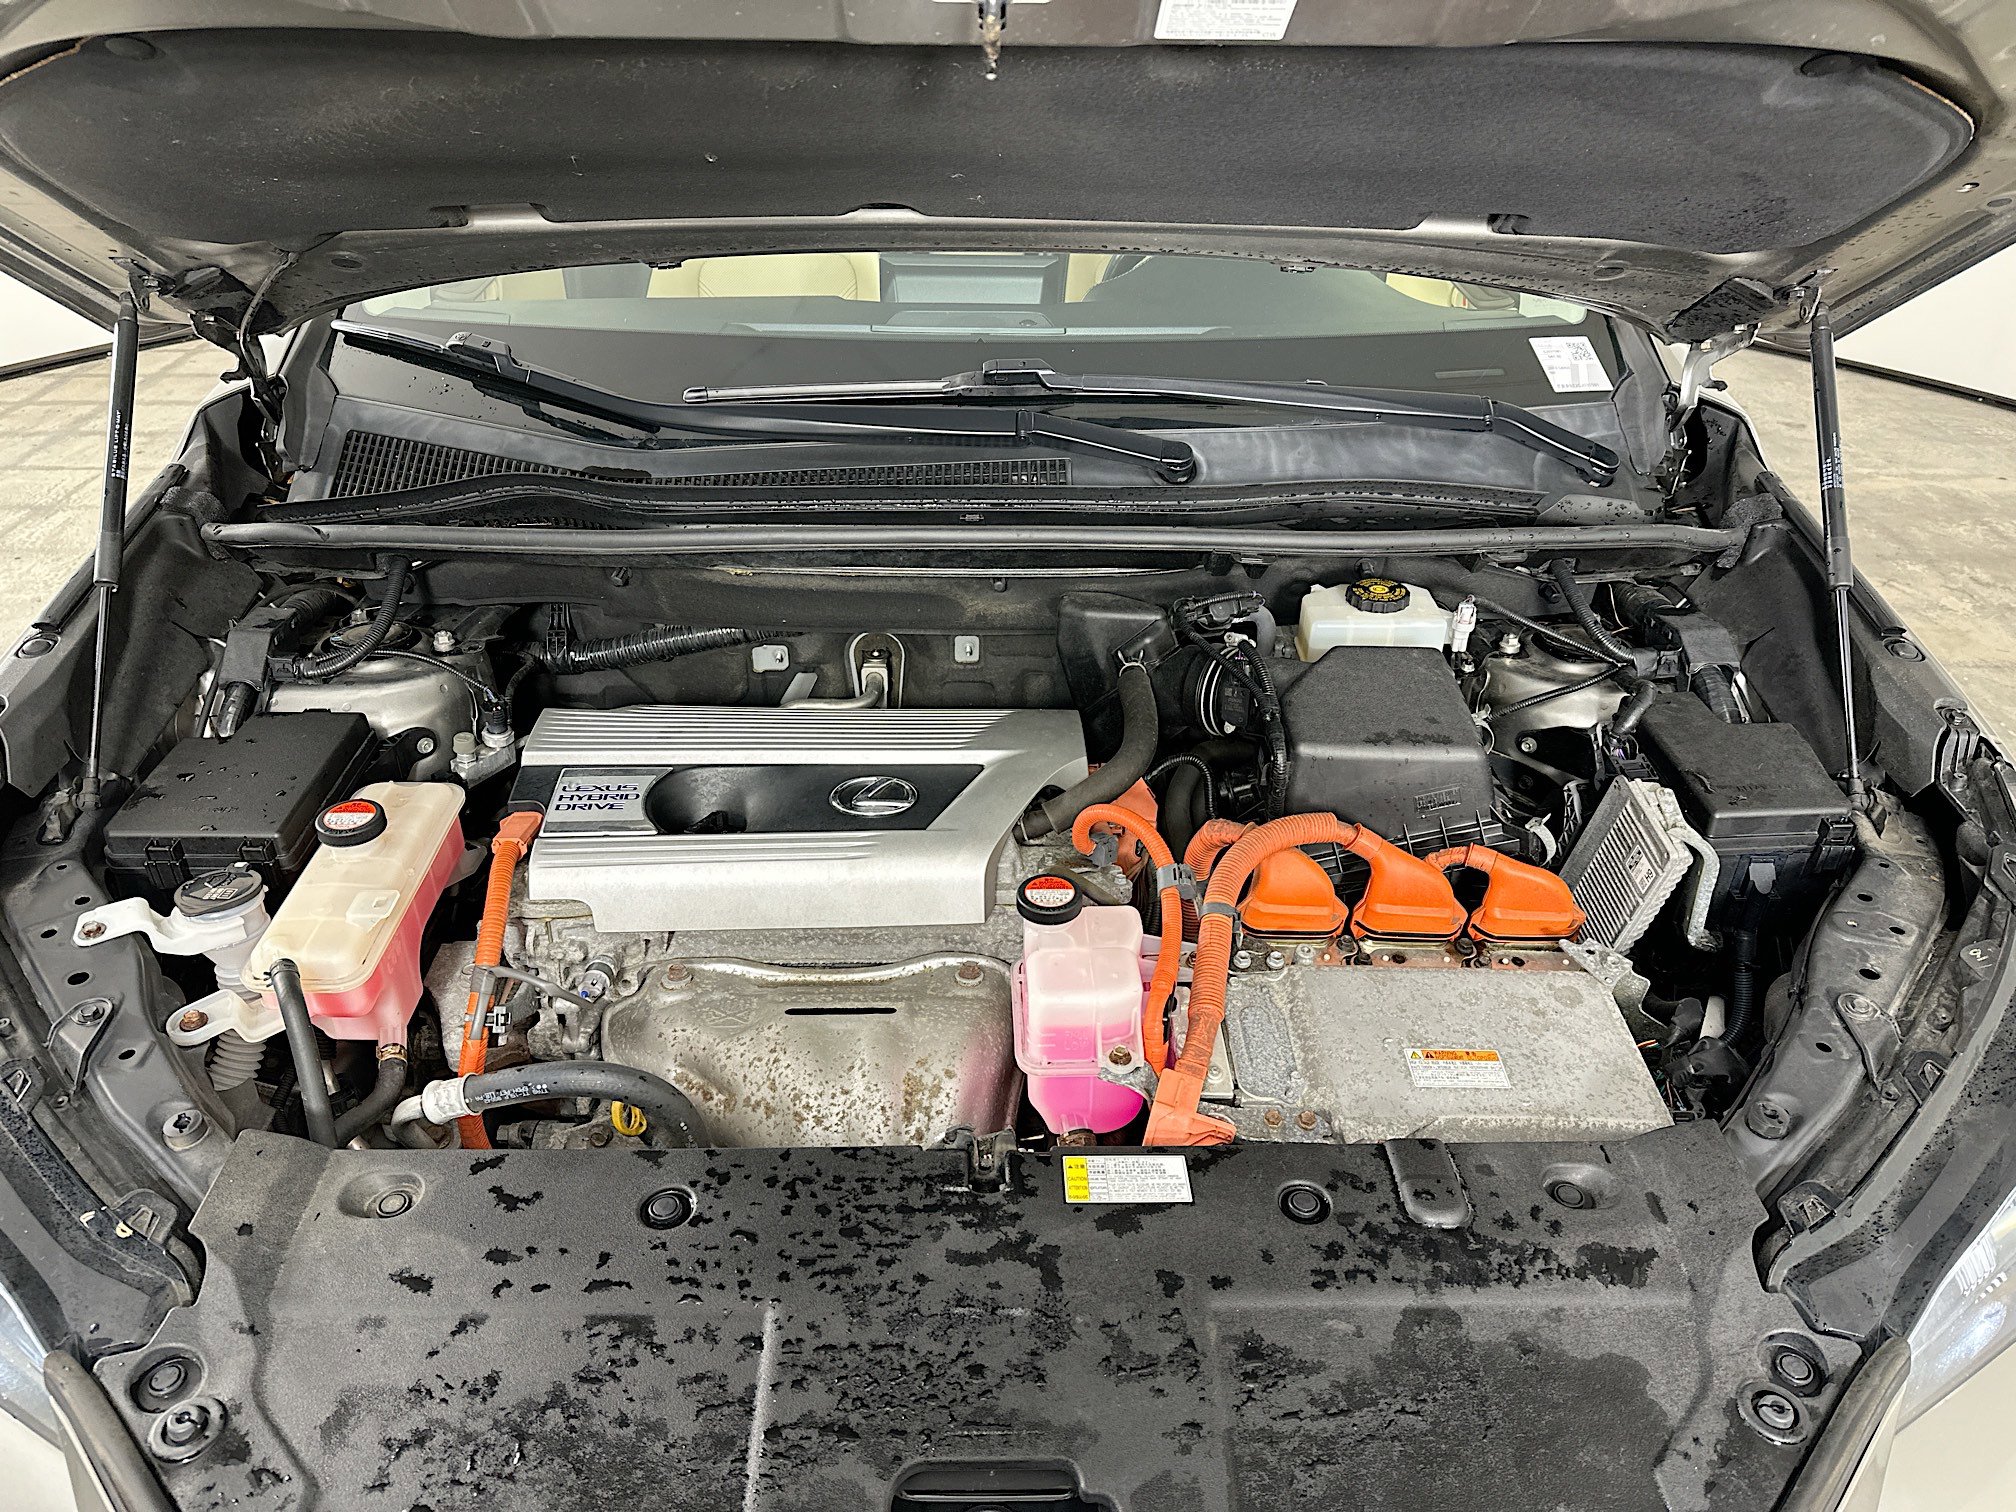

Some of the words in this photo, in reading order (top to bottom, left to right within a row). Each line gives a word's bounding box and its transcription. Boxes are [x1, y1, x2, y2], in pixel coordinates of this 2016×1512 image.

[561, 783, 639, 792] LEXUS
[558, 793, 640, 801] HYBRID
[554, 802, 626, 811] DRIVE
